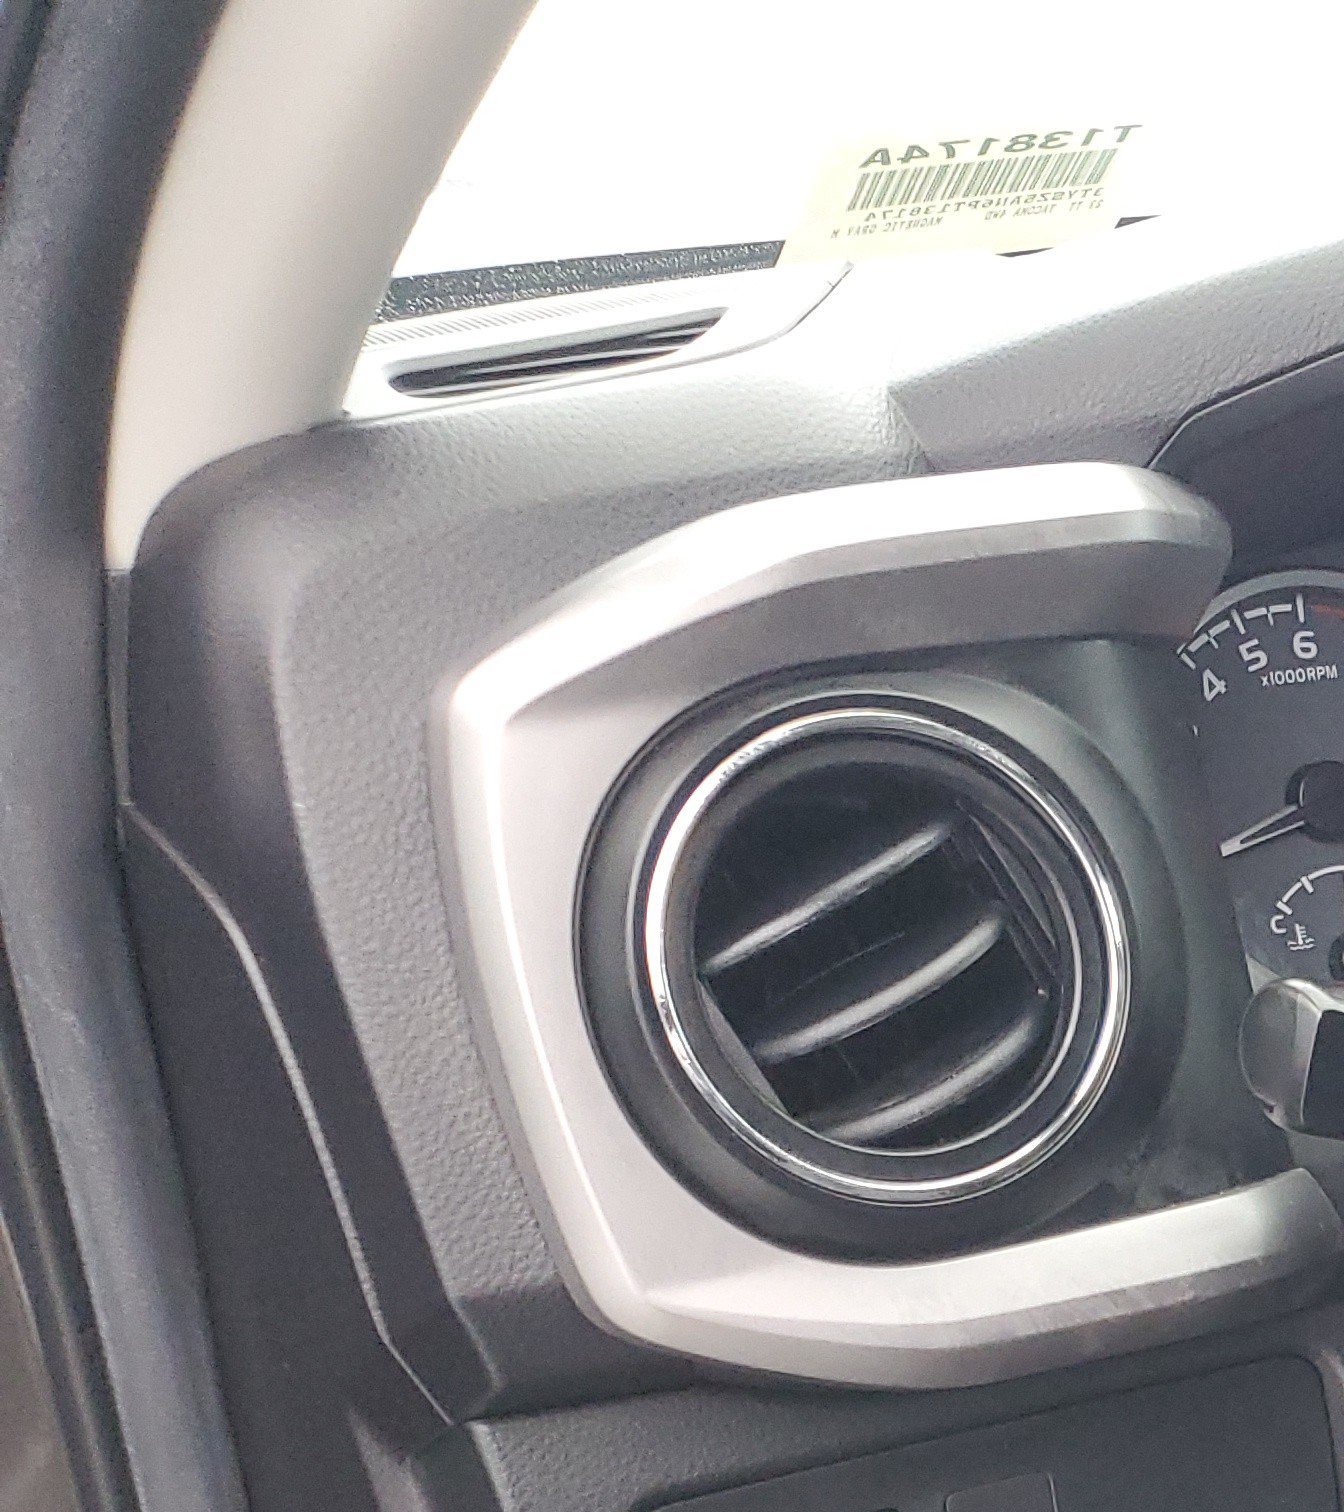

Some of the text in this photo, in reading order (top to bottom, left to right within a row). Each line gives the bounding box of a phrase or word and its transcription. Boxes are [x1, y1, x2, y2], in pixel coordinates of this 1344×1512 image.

[1238, 638, 1269, 673] 5
[1292, 629, 1318, 660] 6
[1201, 667, 1228, 703] 4
